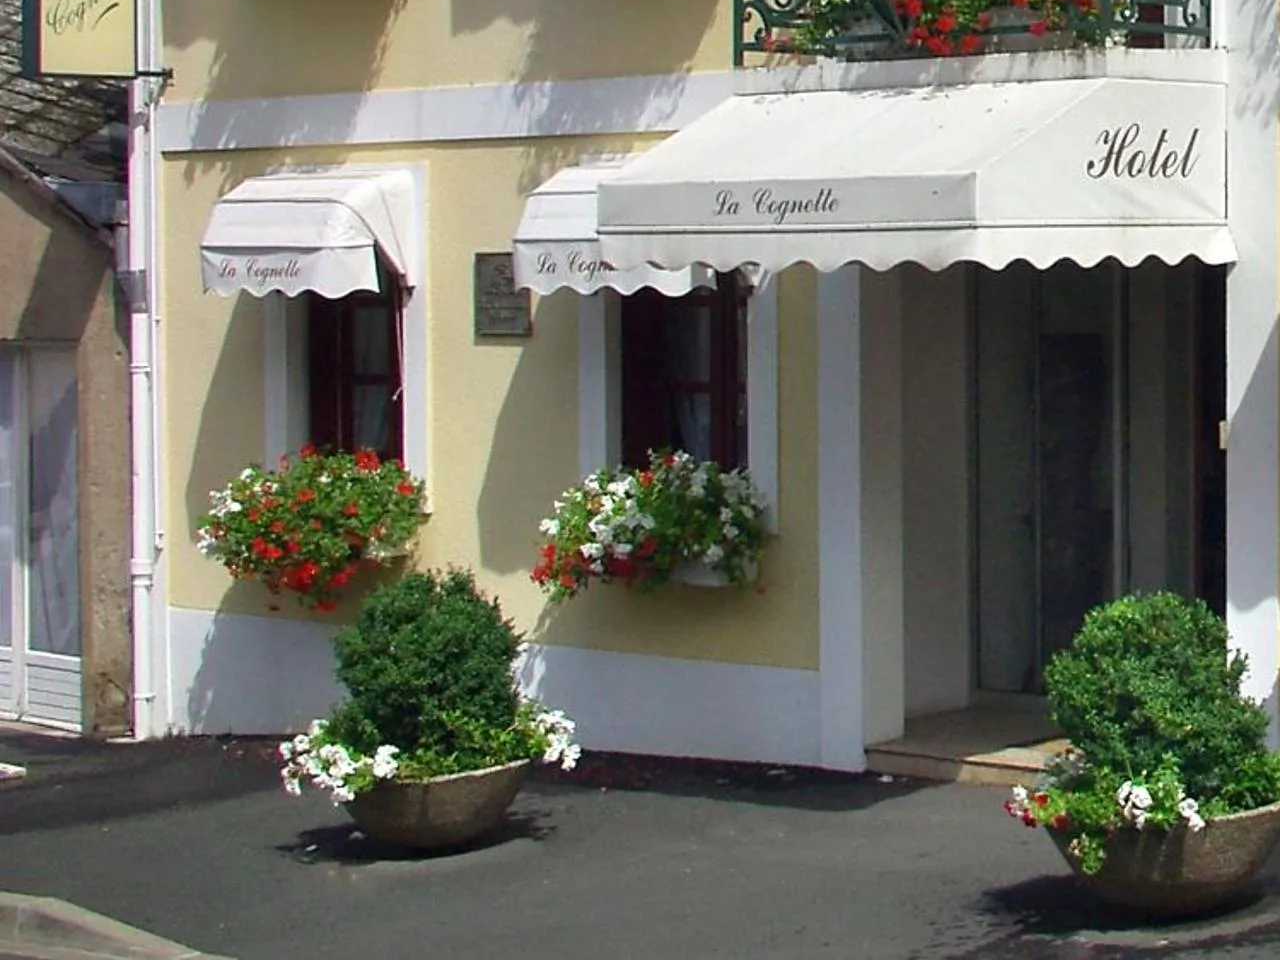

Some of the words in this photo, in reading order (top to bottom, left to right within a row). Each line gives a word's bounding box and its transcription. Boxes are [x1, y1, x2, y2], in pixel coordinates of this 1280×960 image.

[1086, 122, 1200, 179] Hotel
[713, 189, 741, 217] La
[752, 187, 839, 225] Cognette
[218, 259, 237, 279] La
[245, 258, 301, 286] Cognette
[535, 252, 558, 275] La
